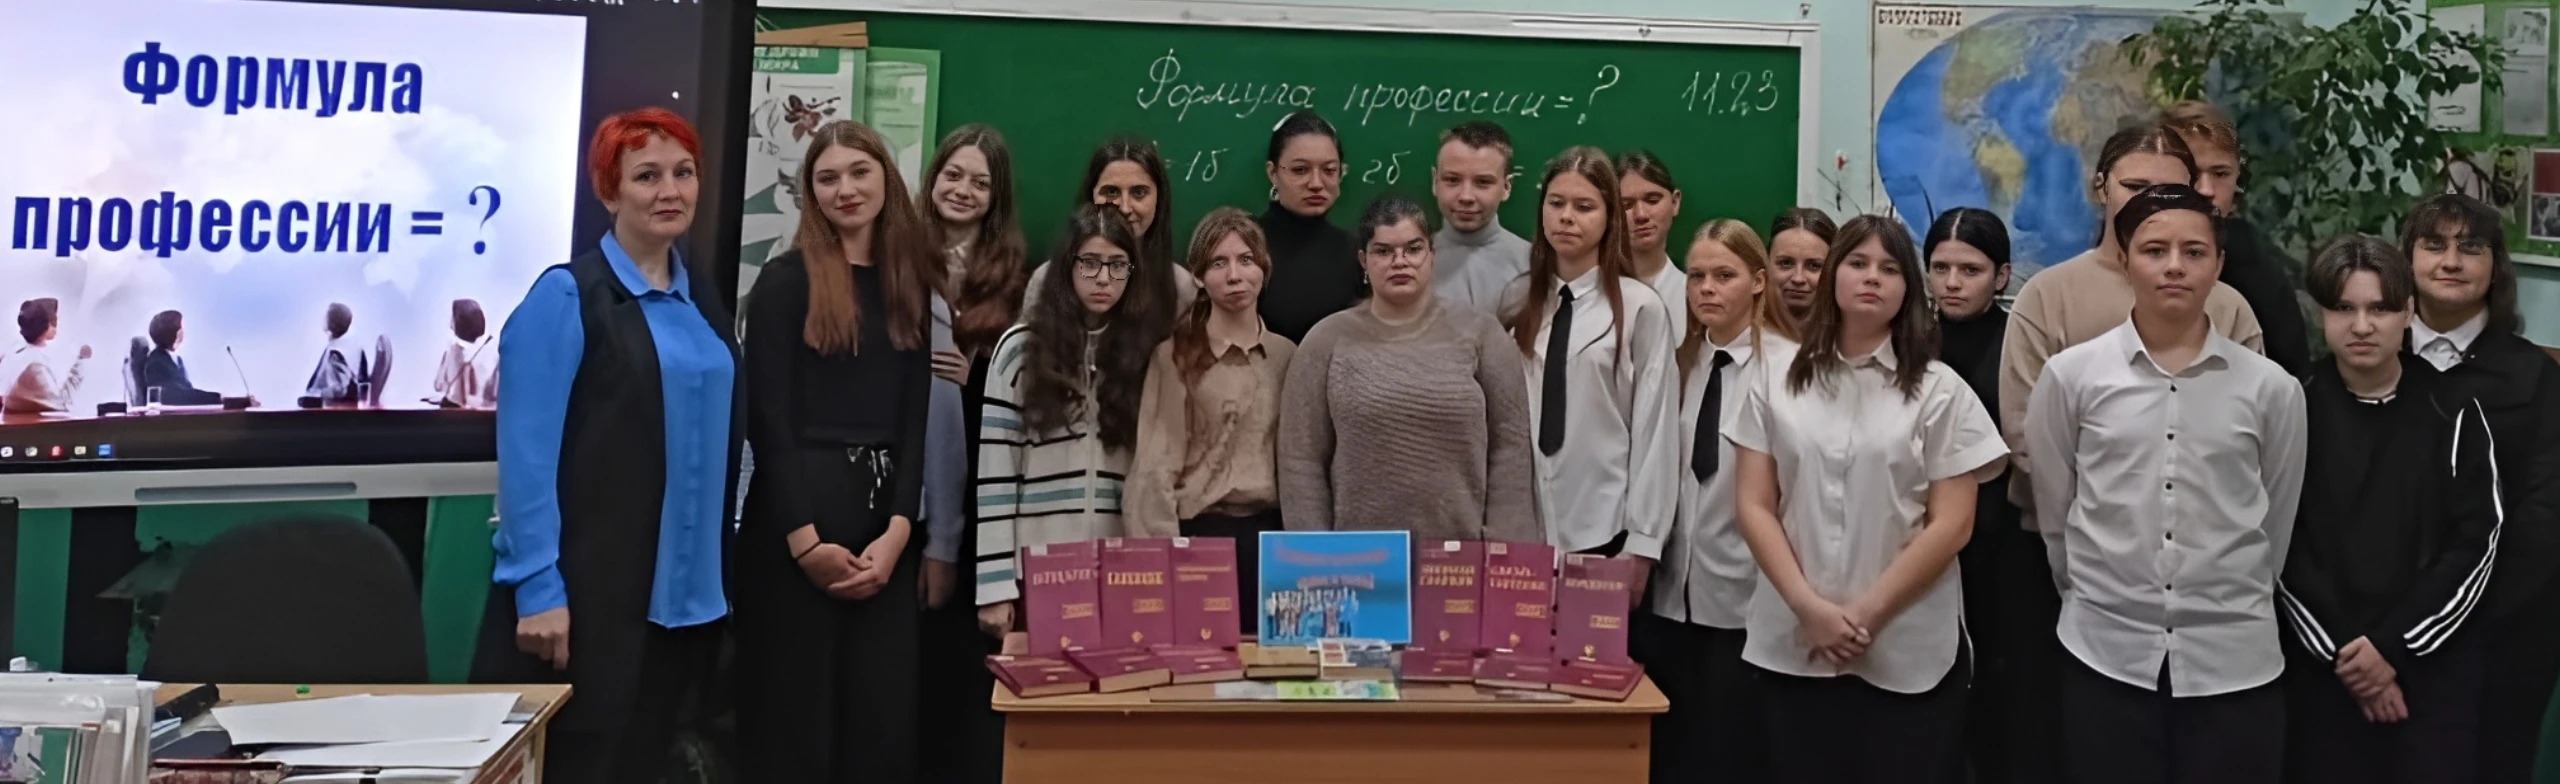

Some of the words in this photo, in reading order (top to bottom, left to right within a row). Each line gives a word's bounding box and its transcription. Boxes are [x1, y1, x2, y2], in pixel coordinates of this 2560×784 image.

[123, 41, 424, 118] Формула
[1136, 48, 1316, 122] Формула
[1343, 83, 1545, 127] профессии
[12, 190, 392, 258] профессии
[410, 210, 444, 236] =
[468, 184, 502, 256] ?
